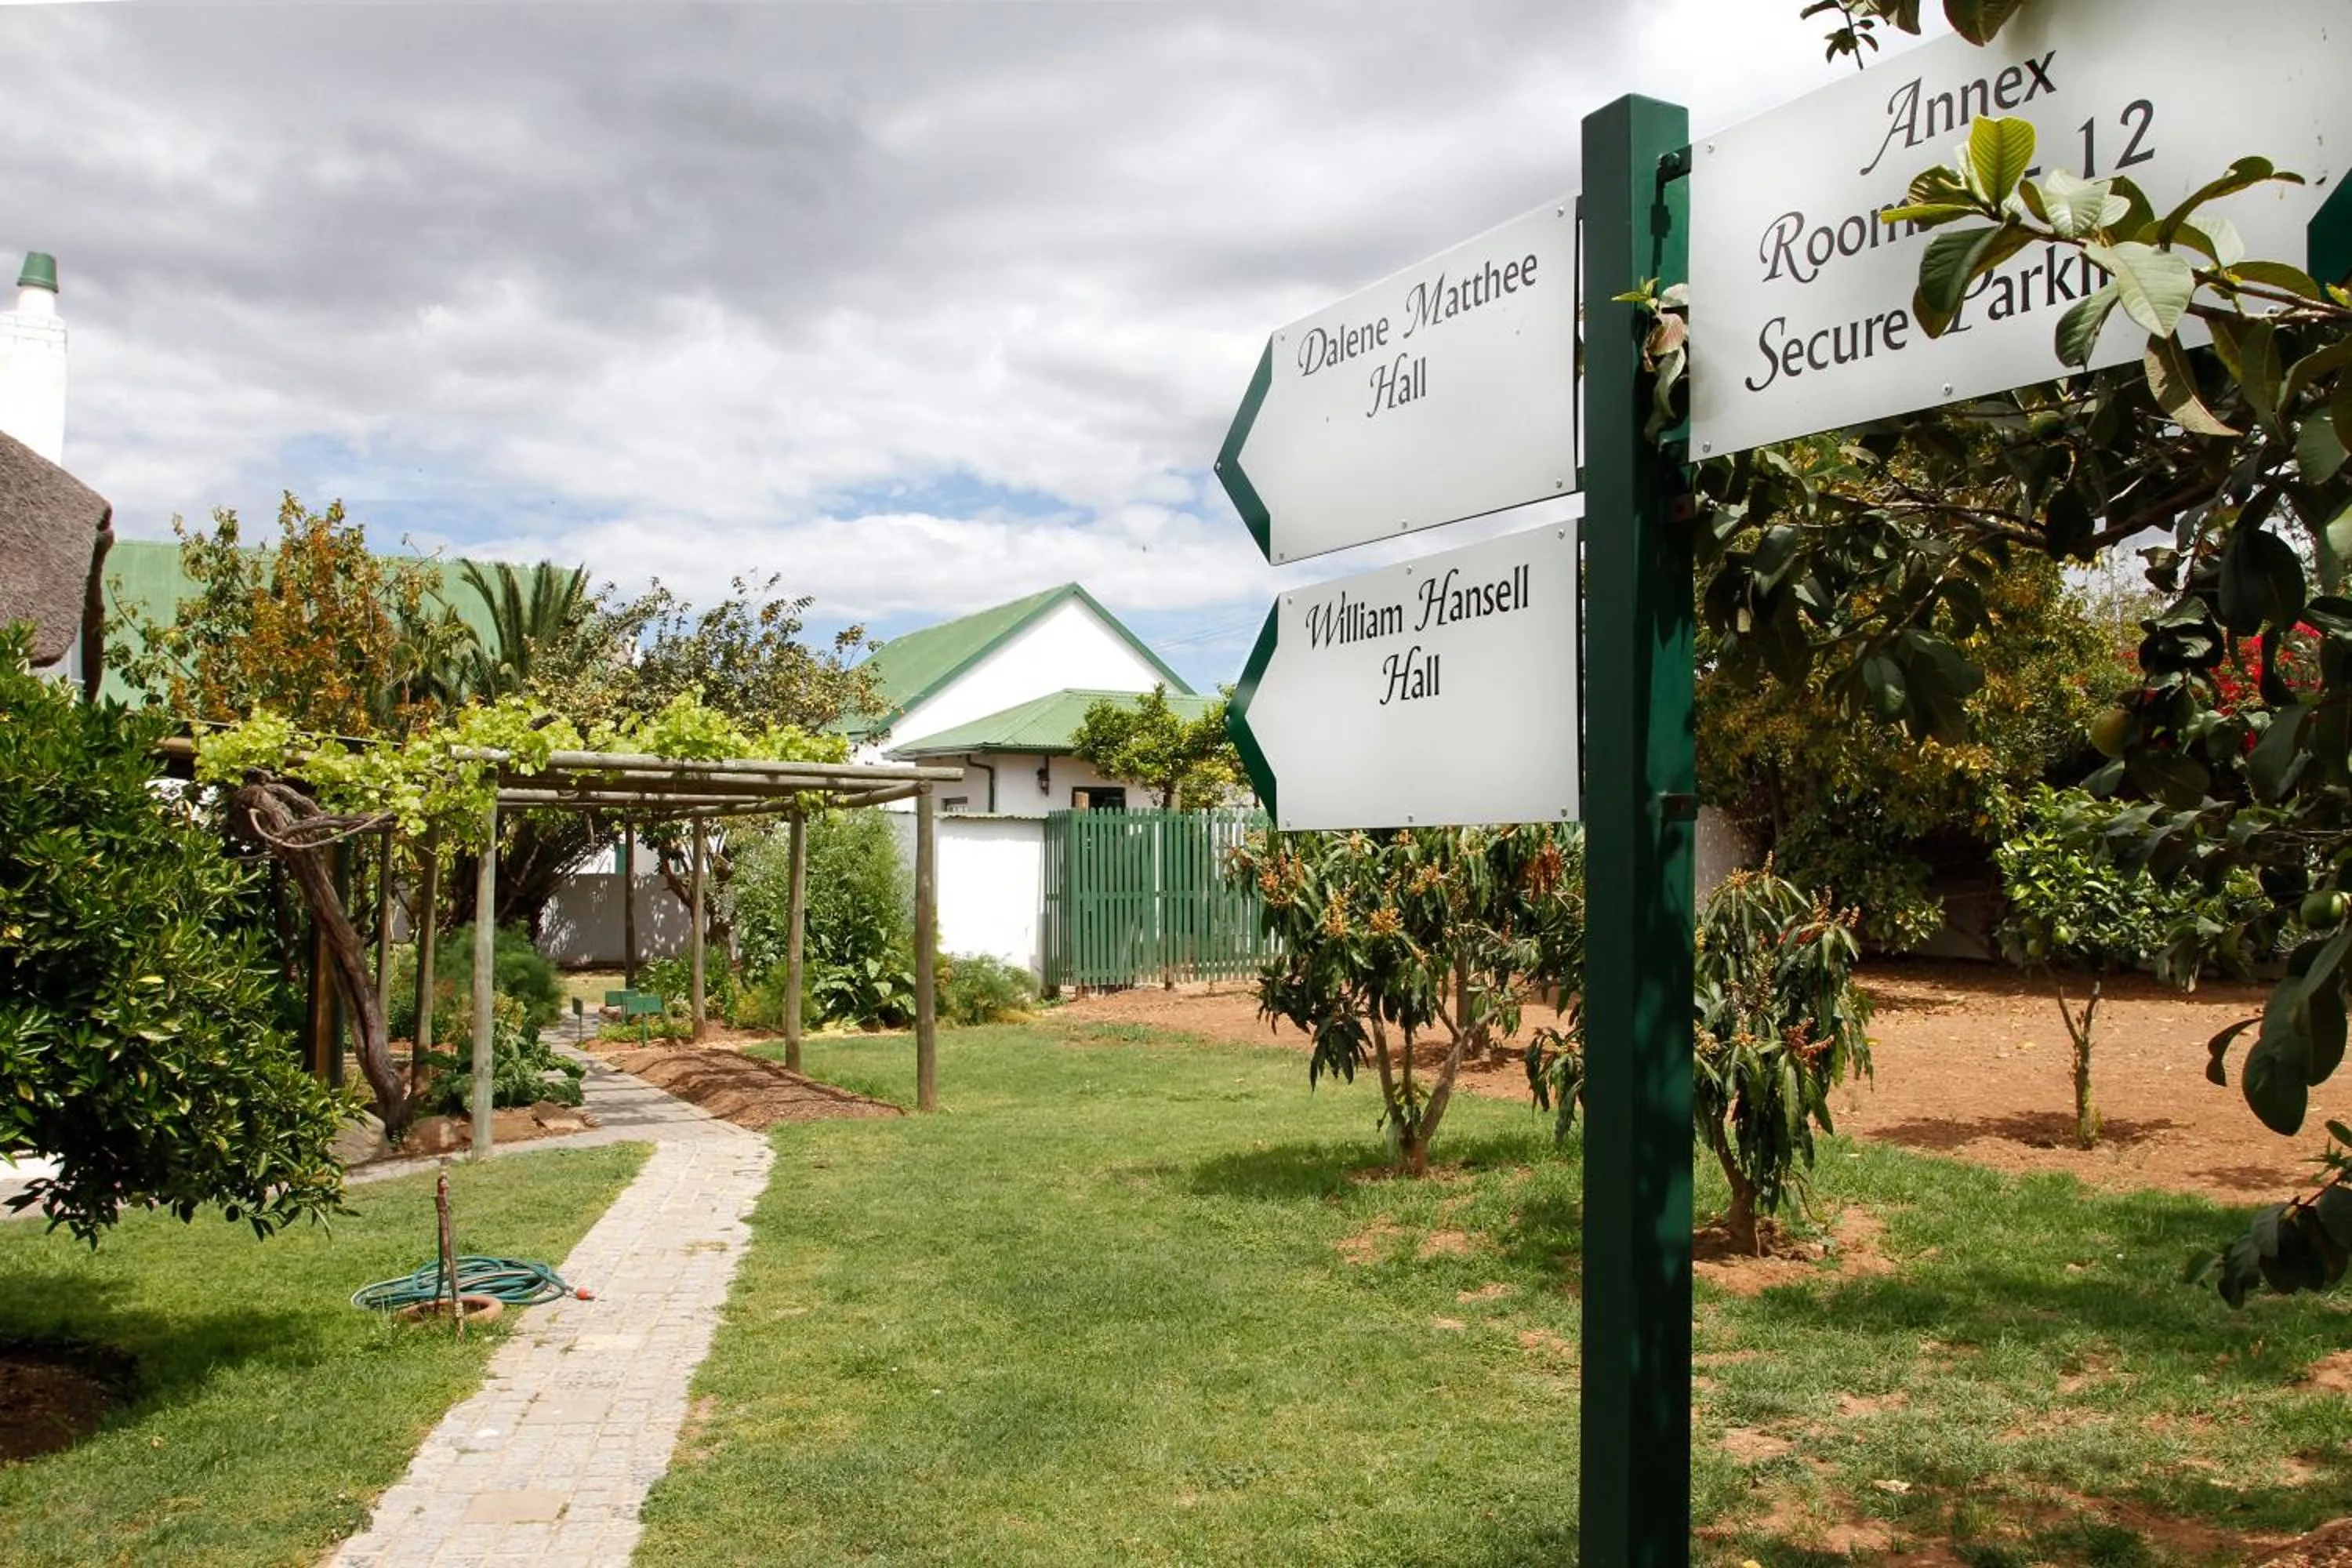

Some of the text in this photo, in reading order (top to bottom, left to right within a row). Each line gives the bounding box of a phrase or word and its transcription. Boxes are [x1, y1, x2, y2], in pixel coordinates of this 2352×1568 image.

[1860, 49, 2057, 176] Annex
[1759, 198, 1933, 284] Room
[1298, 254, 1537, 376] Dalene Matthee
[1744, 245, 2109, 392] Secure arki
[1367, 353, 1427, 418] Hall
[1305, 564, 1529, 651] William Hansell
[1380, 646, 1440, 705] Hall
